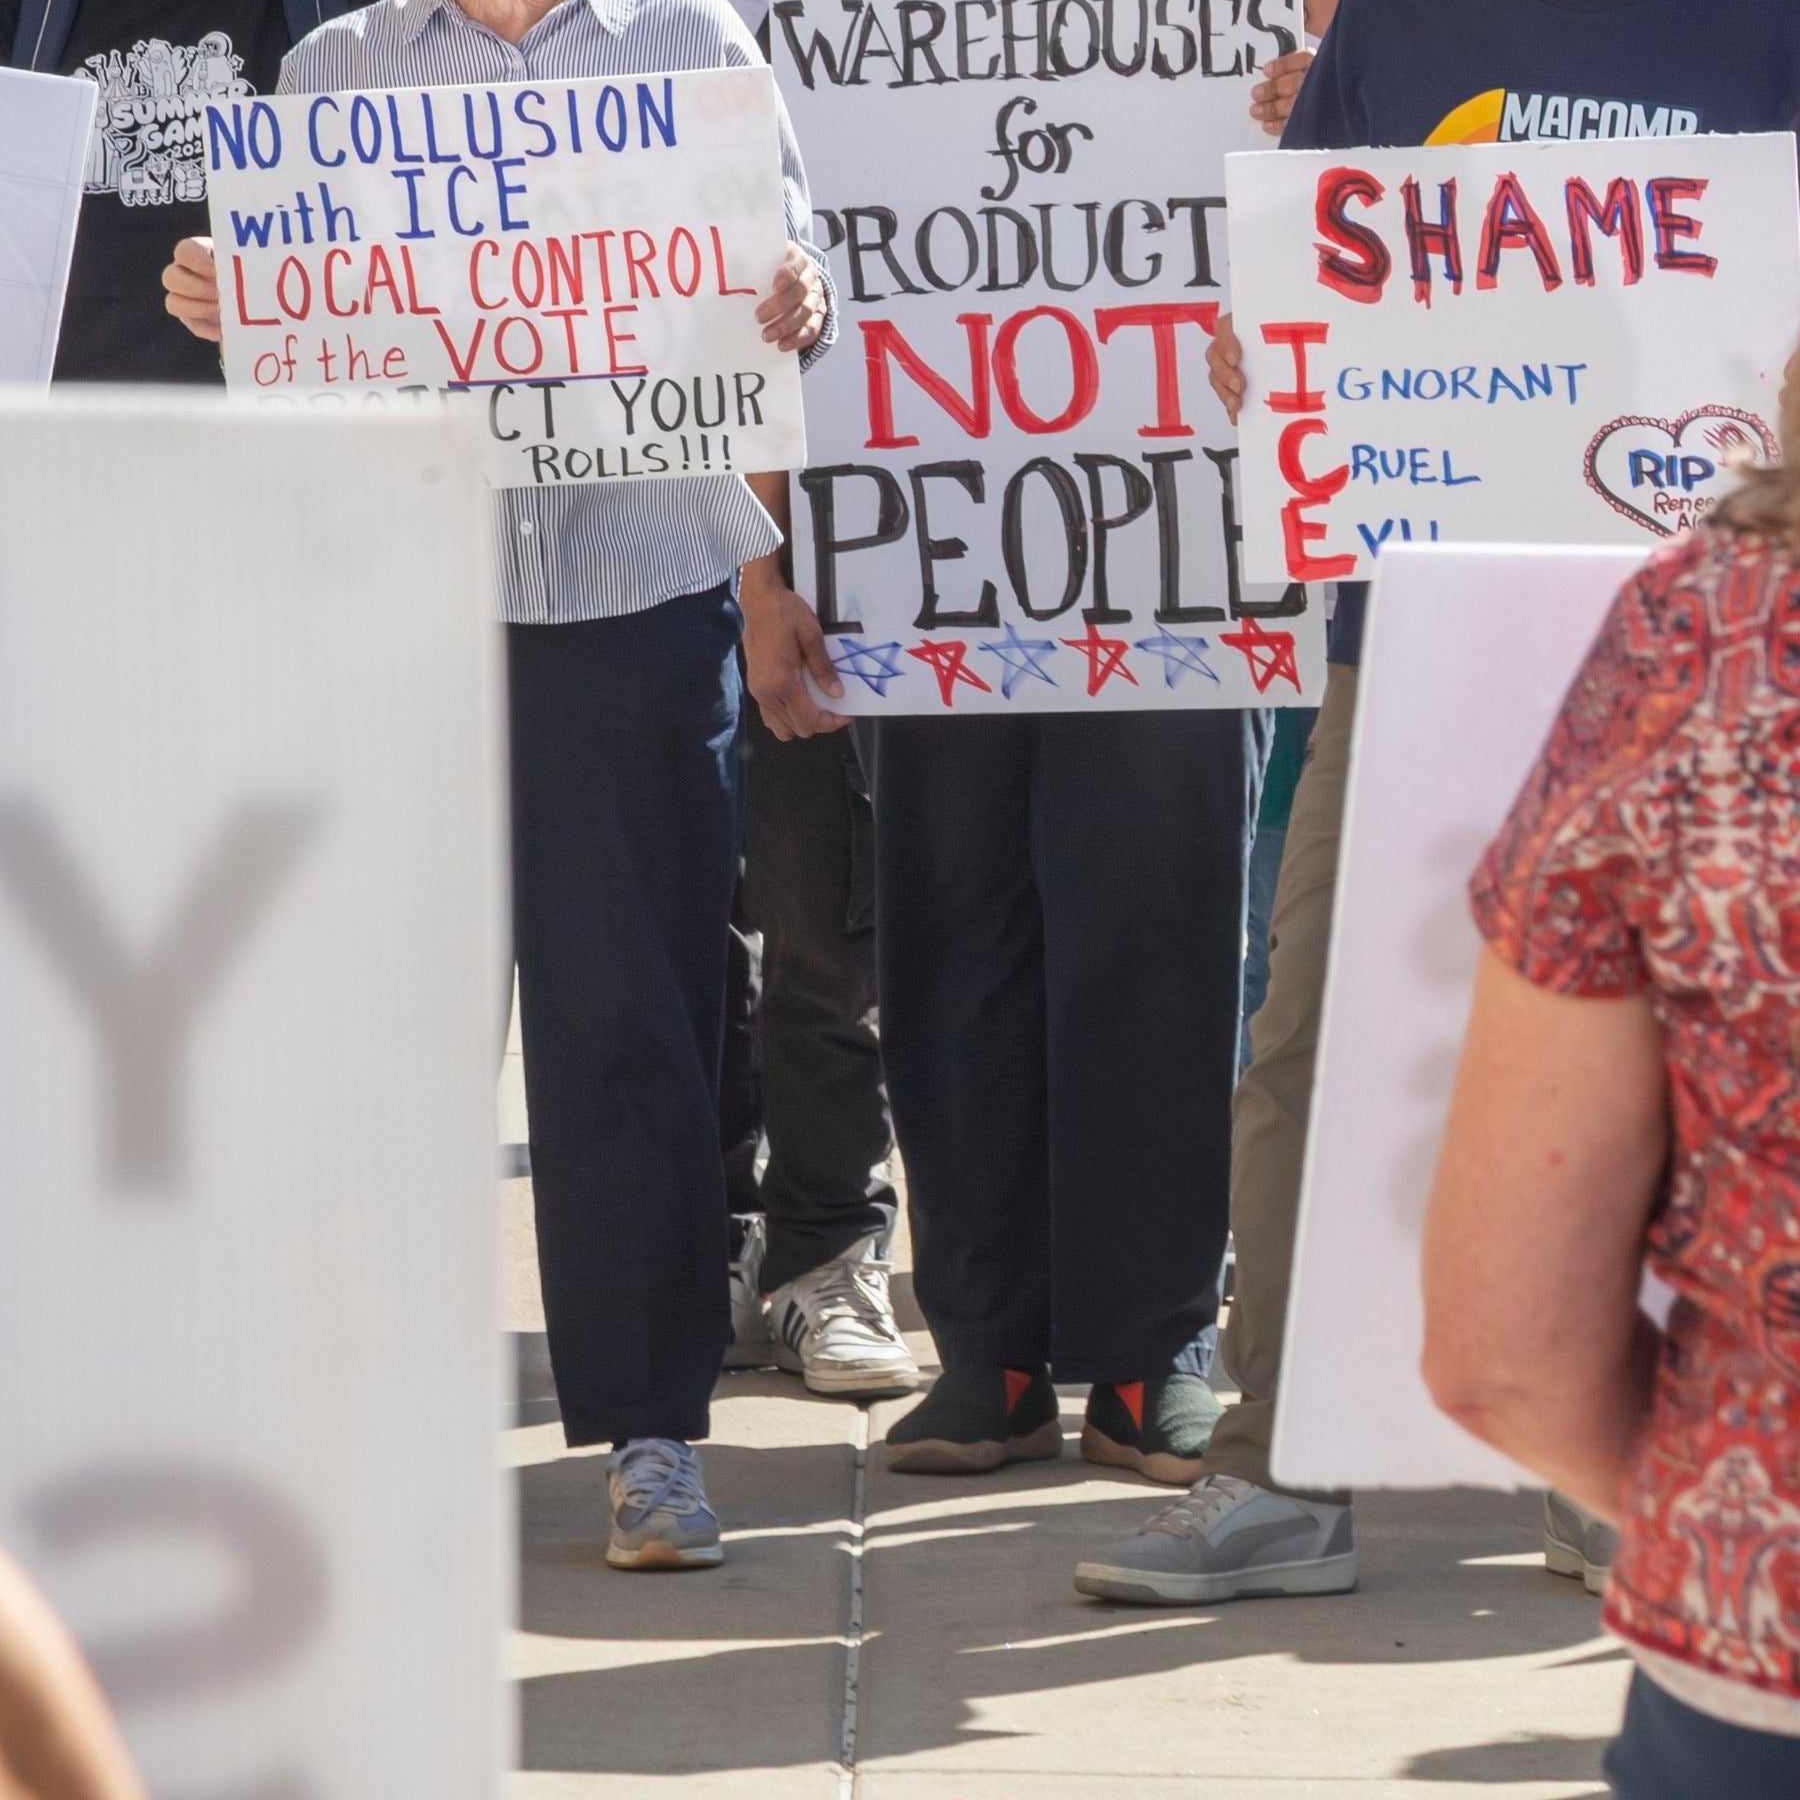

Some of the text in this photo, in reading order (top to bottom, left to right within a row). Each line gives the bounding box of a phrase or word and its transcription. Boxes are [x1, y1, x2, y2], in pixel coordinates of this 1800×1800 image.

[140, 116, 202, 150] GAM
[172, 140, 202, 160] 202
[205, 101, 282, 171] NO
[308, 77, 678, 168] COLLUSION
[980, 95, 1095, 202] for
[230, 157, 530, 248] with ICE
[1313, 166, 1719, 309] SHAME
[232, 225, 758, 326] LOCAL CONTROL
[253, 304, 649, 387] of the VOTE
[857, 301, 1220, 450] NOT
[610, 370, 766, 436] YOUR
[522, 433, 732, 483] ROLLS!!!
[1628, 448, 1716, 493] RIP
